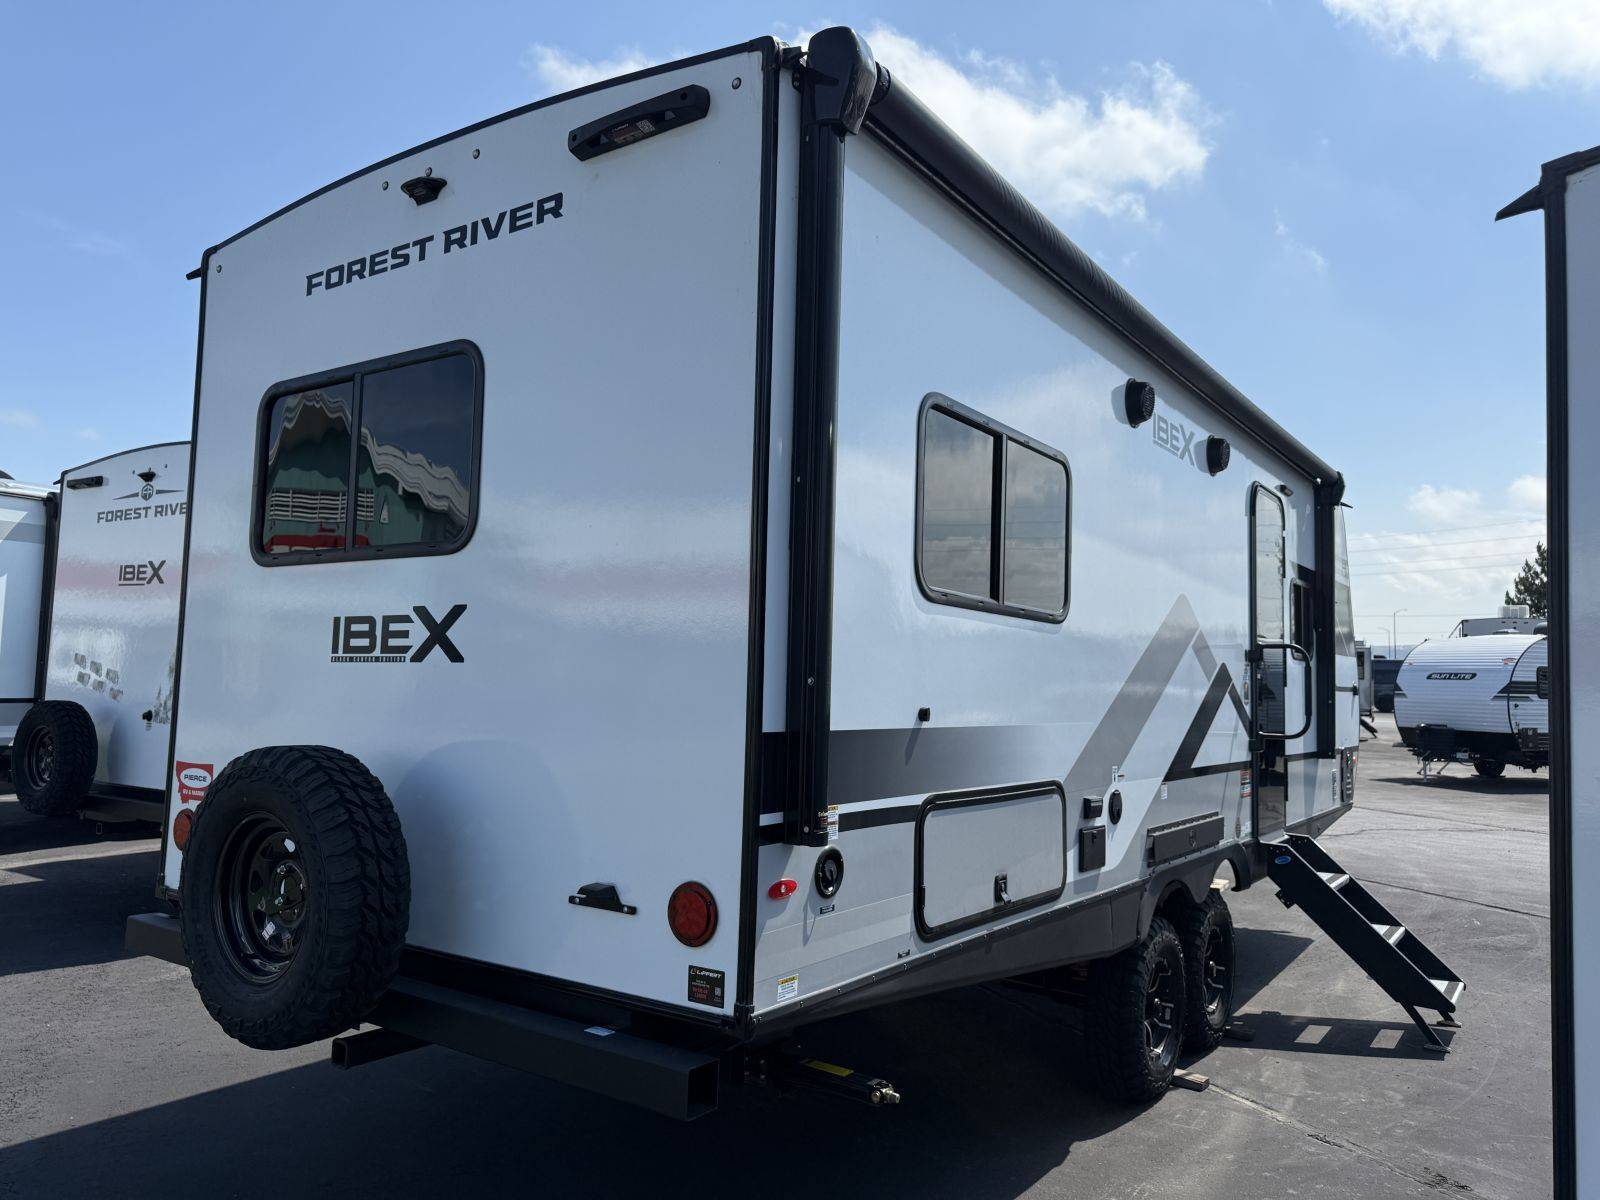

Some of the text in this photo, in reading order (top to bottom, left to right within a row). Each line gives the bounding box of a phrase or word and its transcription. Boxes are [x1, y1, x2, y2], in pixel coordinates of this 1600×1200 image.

[306, 192, 563, 296] FOREST RIVER
[1152, 411, 1195, 467] IBEX
[97, 502, 187, 524] FOREST RIVE
[118, 560, 166, 585] IBEX
[331, 604, 467, 663] IBEX
[184, 774, 207, 782] PIERCE
